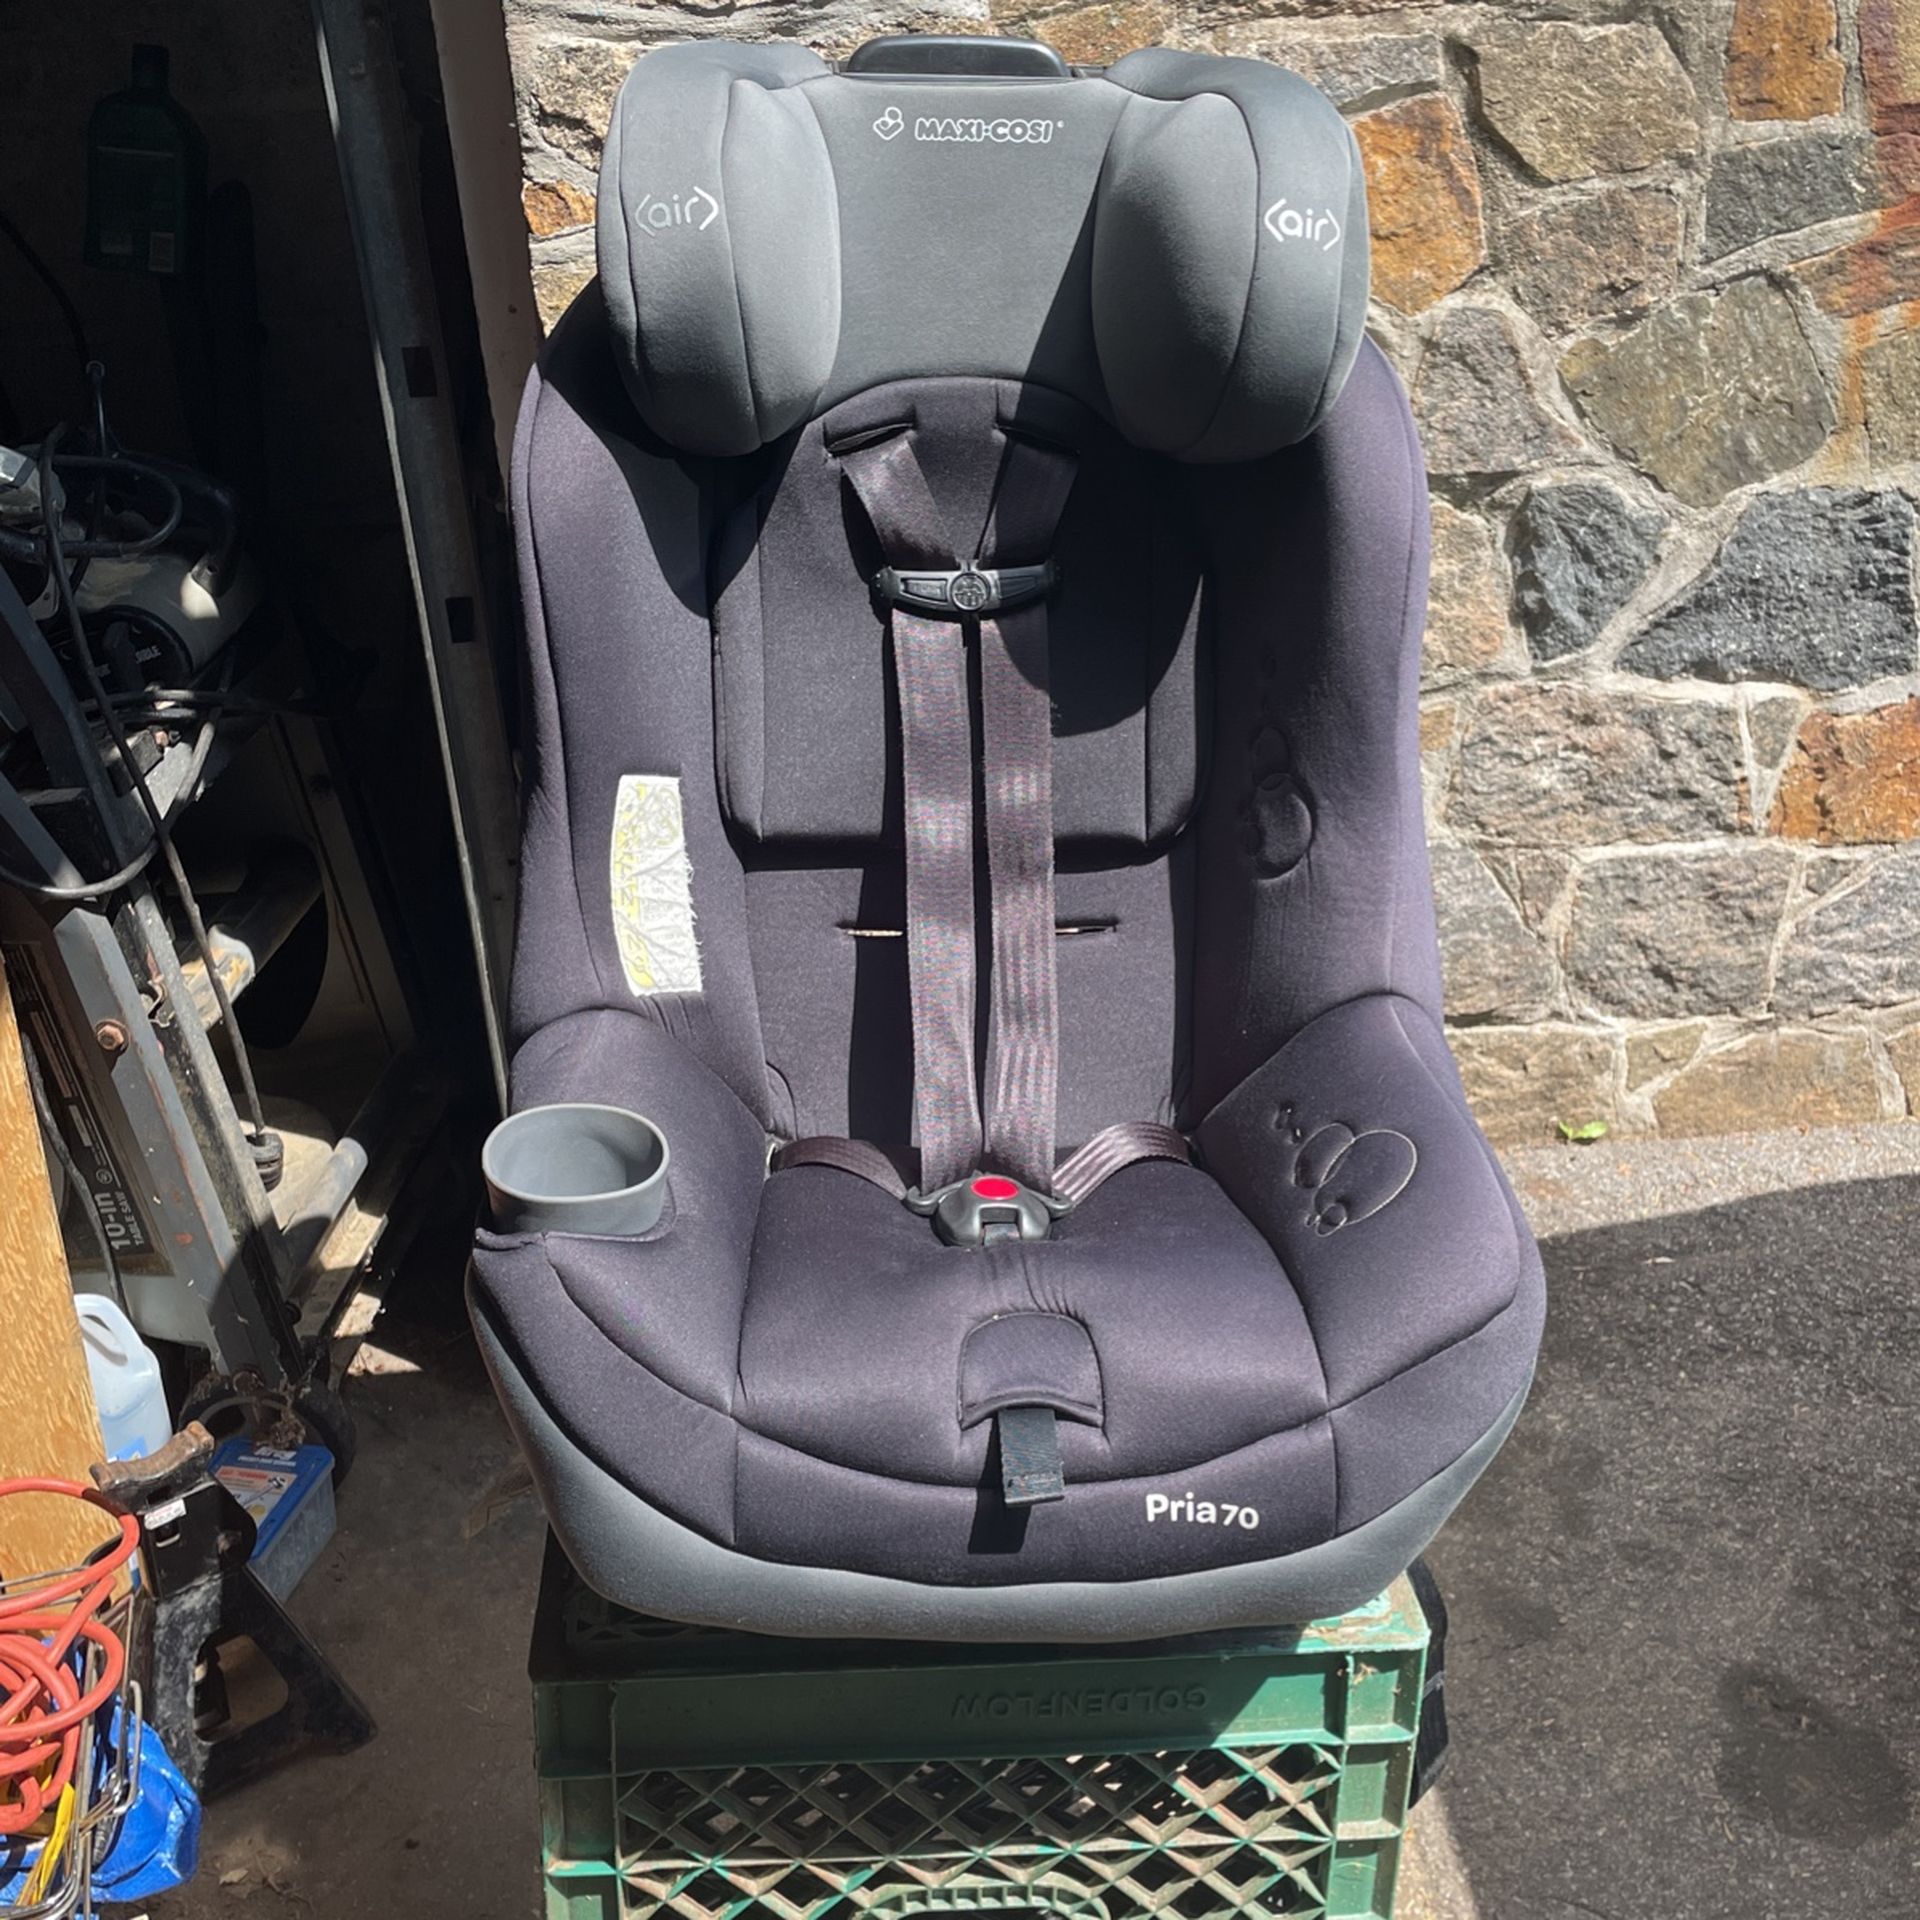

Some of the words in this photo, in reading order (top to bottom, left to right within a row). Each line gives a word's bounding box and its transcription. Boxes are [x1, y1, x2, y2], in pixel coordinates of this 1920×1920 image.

[125, 1214, 145, 1246] TABLE
[1145, 1492, 1217, 1524] Pria
[1220, 1503, 1260, 1530] 70
[951, 1686, 1211, 1719] GOLDENFLOW
